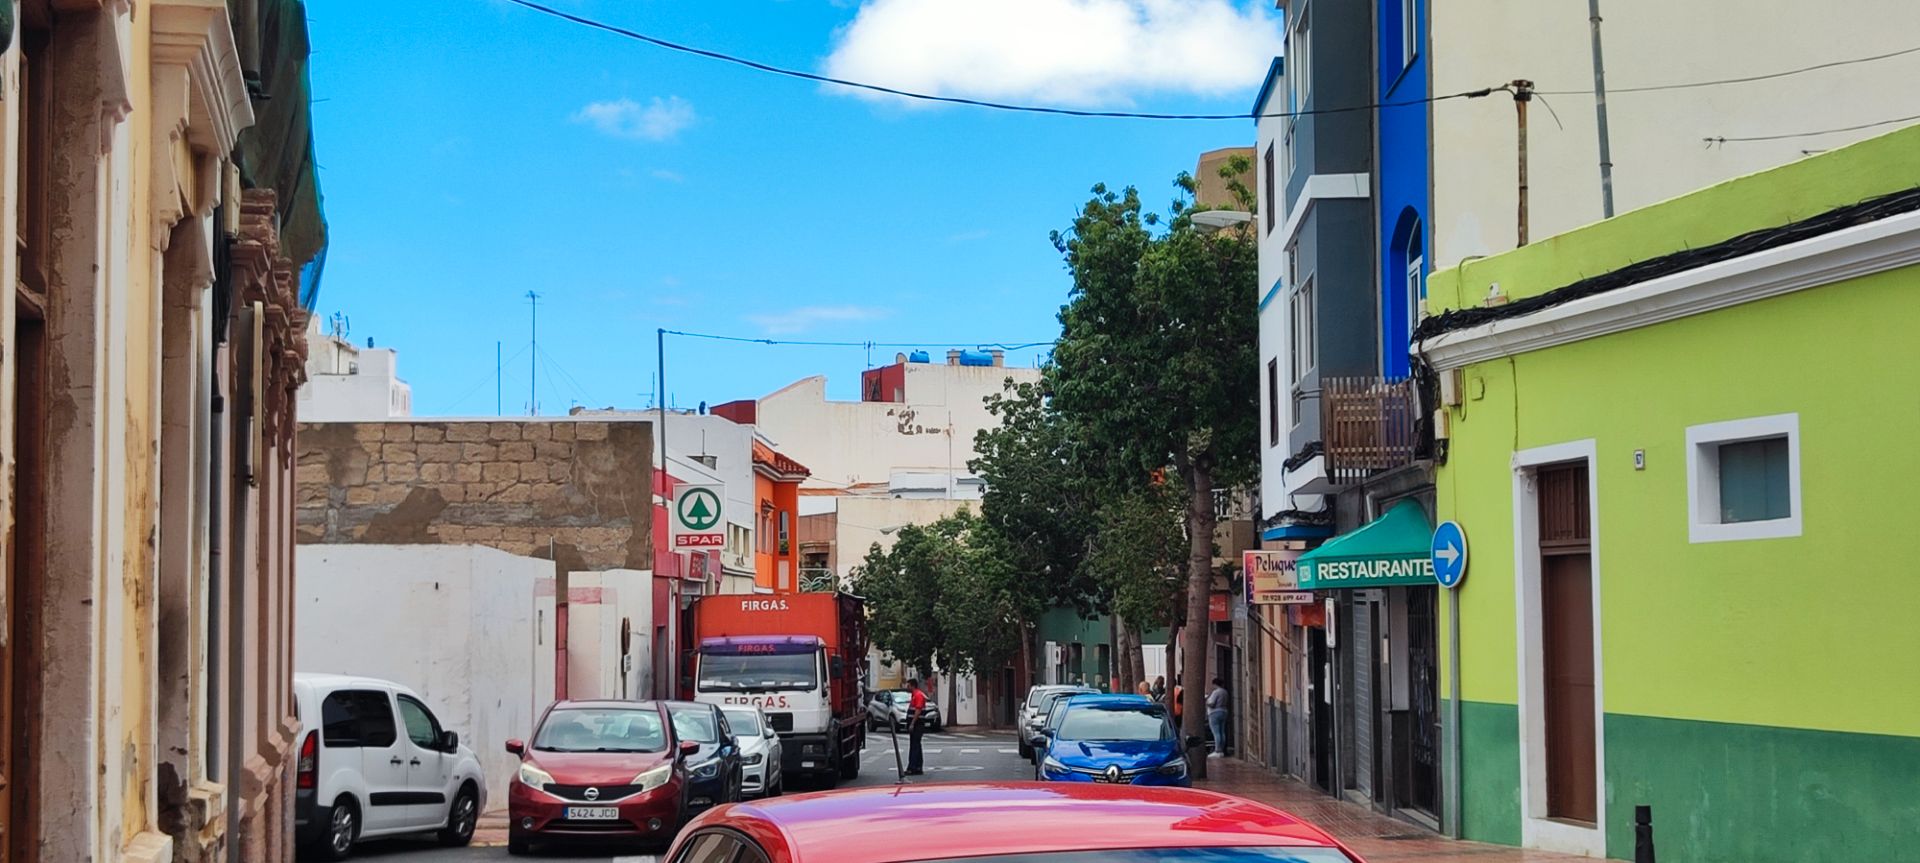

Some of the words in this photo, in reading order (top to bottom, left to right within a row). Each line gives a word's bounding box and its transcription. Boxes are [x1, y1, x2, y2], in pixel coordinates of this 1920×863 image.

[677, 535, 723, 545] SPAR
[1317, 559, 1435, 580] RESTAURANTE
[741, 600, 790, 611] FIRGAS.
[570, 808, 595, 818] 5424
[599, 808, 617, 818] JCD
